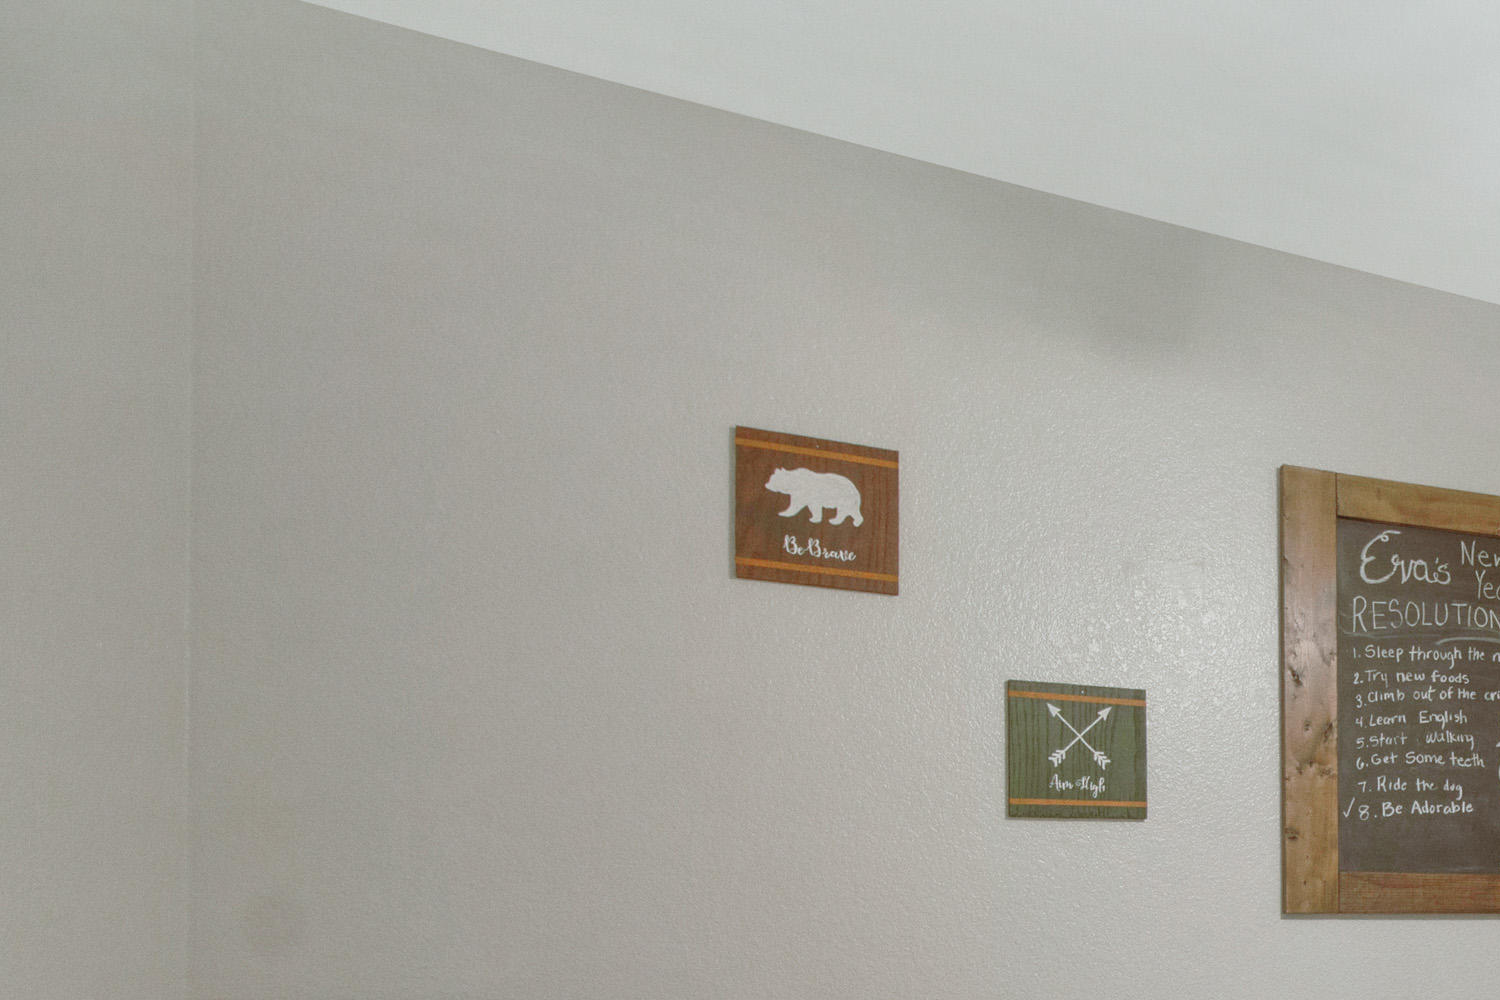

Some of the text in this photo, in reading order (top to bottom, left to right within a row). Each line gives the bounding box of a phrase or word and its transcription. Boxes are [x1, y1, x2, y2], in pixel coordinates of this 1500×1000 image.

[783, 534, 857, 562] Be Brave
[1360, 530, 1451, 584] Eva's
[1365, 644, 1404, 663] Sleep
[1409, 645, 1462, 669] through
[1468, 646, 1485, 660] the
[1365, 669, 1388, 688] Try
[1396, 671, 1425, 682] new
[1431, 670, 1470, 684] foods
[1413, 685, 1436, 702] out
[1440, 686, 1454, 700] of
[1457, 688, 1477, 700] the
[1369, 713, 1407, 727] Learn
[1419, 709, 1467, 730] English
[1371, 752, 1398, 765] Get
[1449, 751, 1485, 768] teeth
[1048, 774, 1105, 798] Aim High
[1377, 776, 1407, 792] Ride
[1416, 778, 1438, 792] the
[1443, 779, 1463, 800] dog
[1382, 802, 1403, 817] Be
[1411, 800, 1473, 814] Adorable
